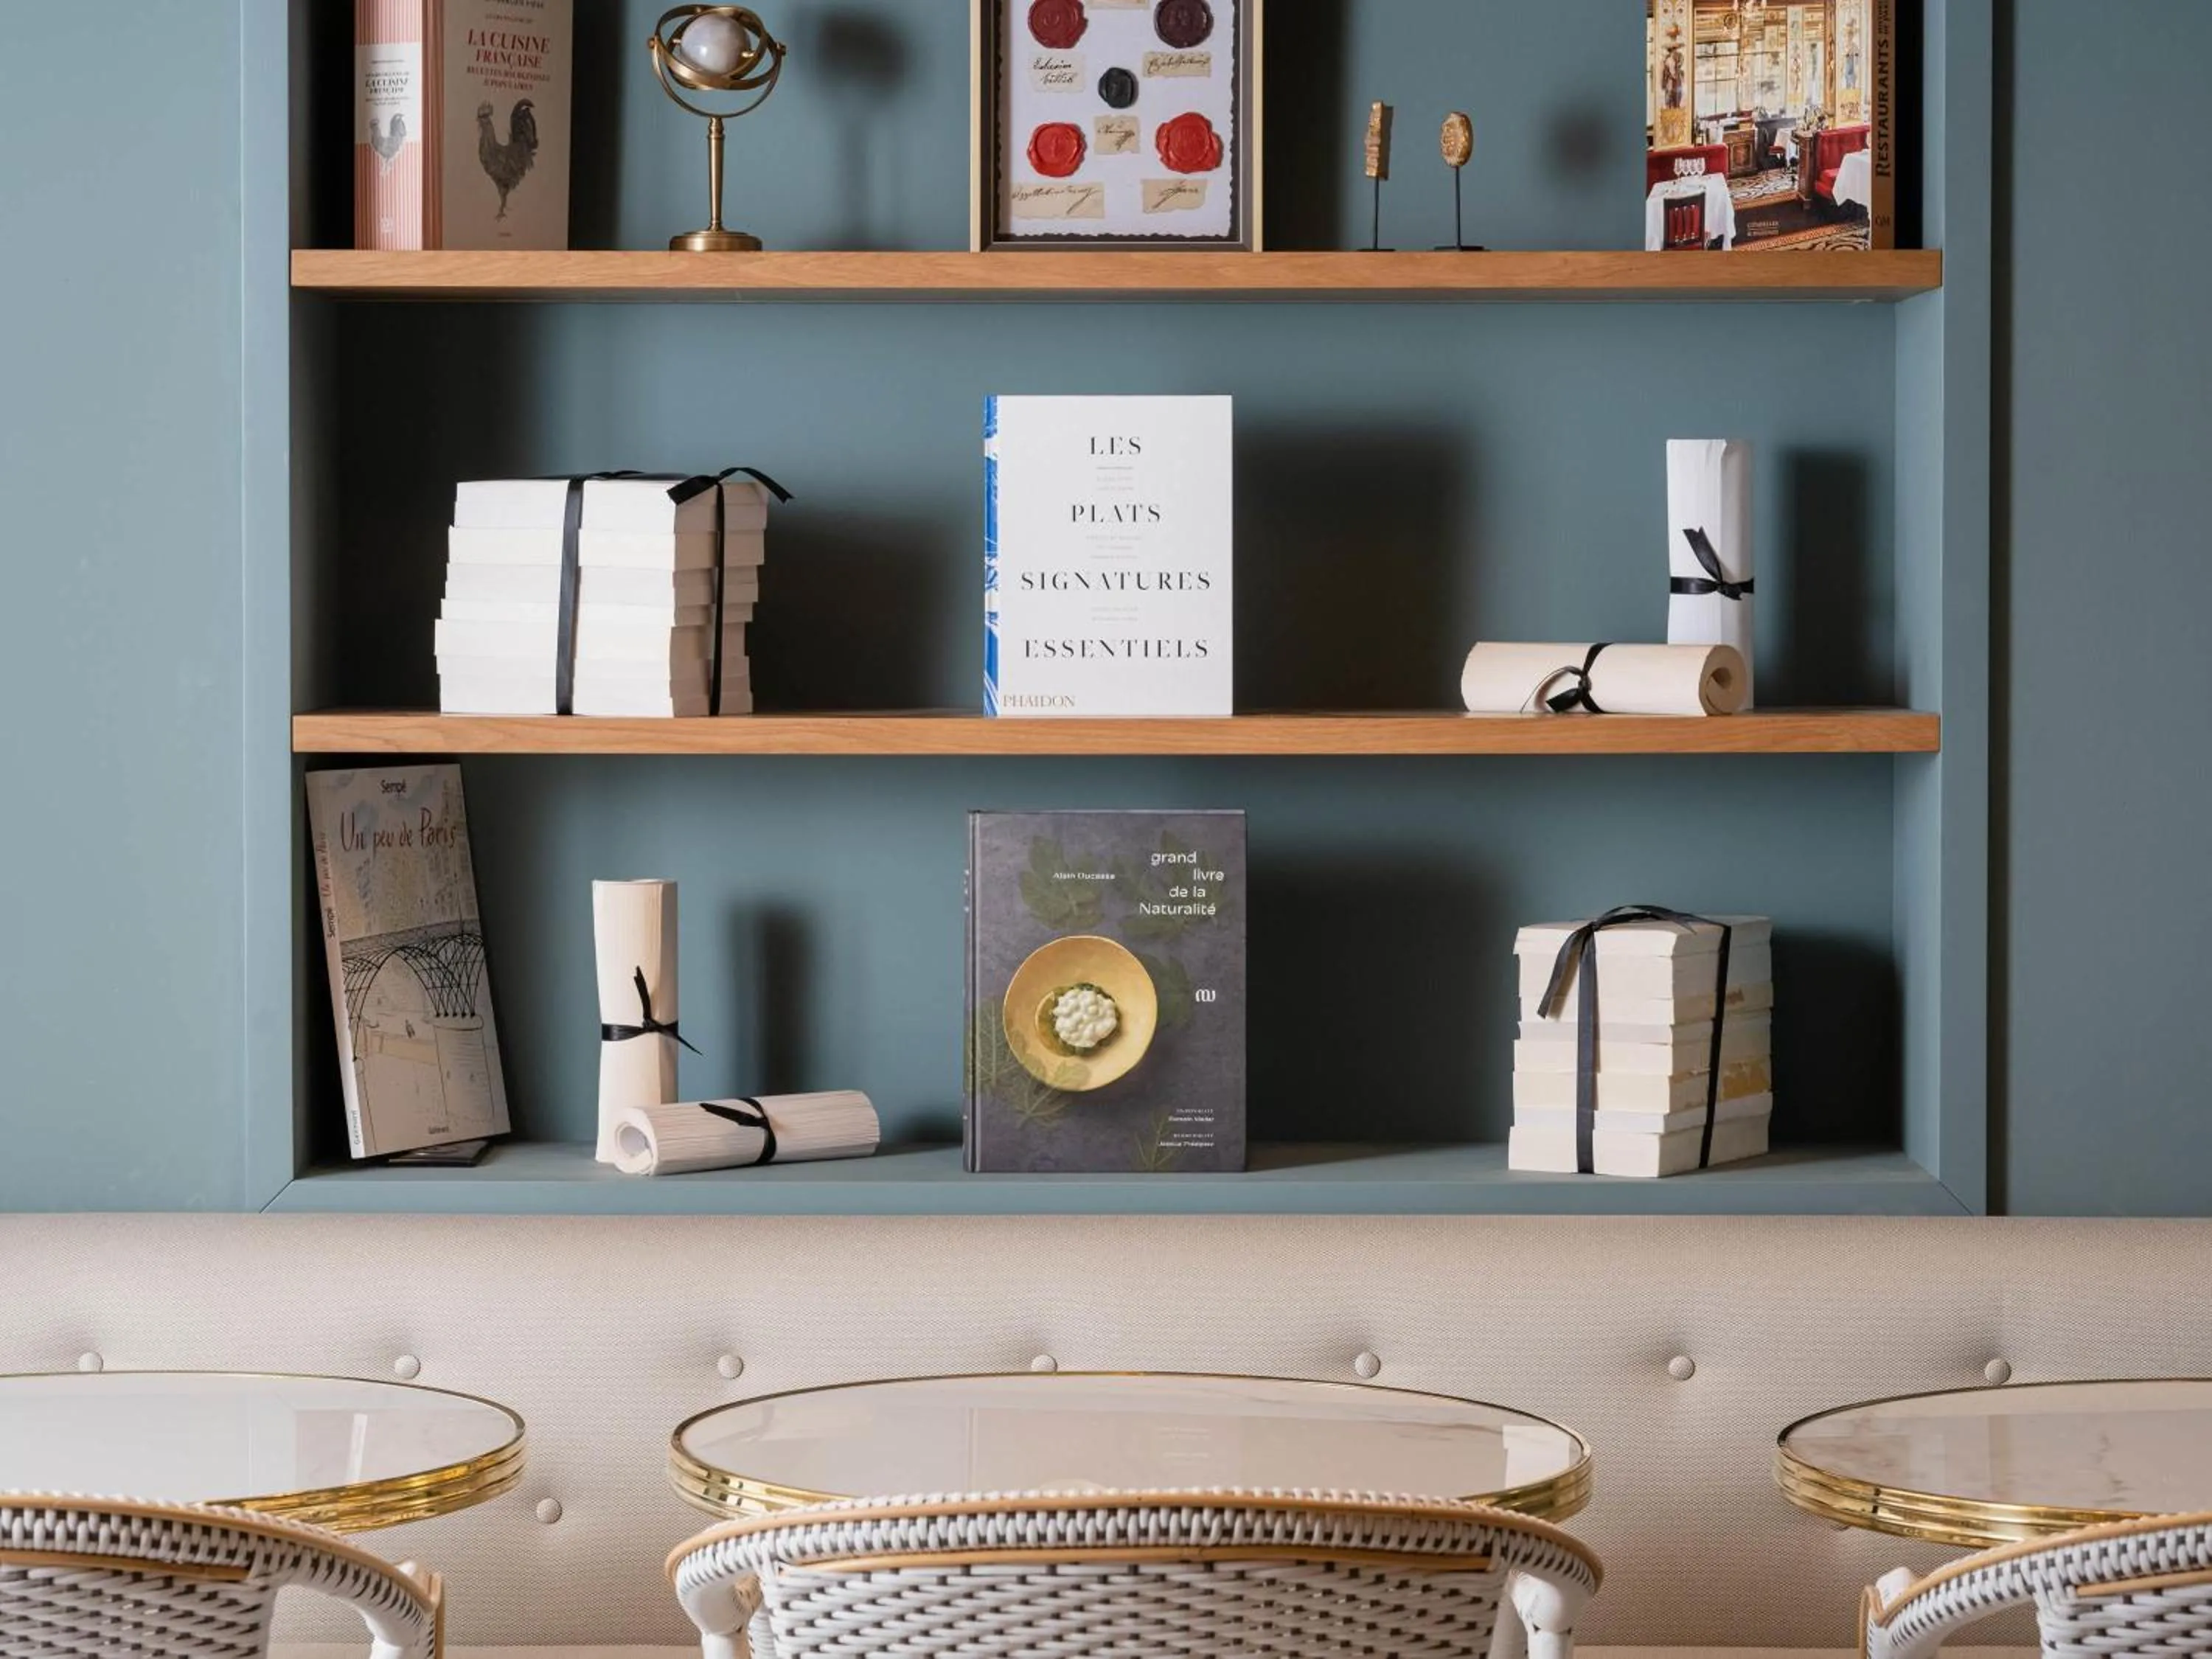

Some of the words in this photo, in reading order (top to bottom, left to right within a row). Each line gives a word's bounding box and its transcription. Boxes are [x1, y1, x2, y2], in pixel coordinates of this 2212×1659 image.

[467, 28, 486, 46] LA
[490, 31, 550, 53] CUISINE
[476, 49, 543, 70] FRANÇAISE
[1874, 39, 1891, 177] RESTAURANTS
[1090, 436, 1142, 455] LES
[1071, 504, 1161, 523] PLATS
[1020, 571, 1211, 591] SIGNATURES
[1025, 639, 1208, 658] ESSENTIELS
[1004, 695, 1075, 708] PHAIDON
[380, 779, 407, 799] Sempé
[341, 812, 364, 852] Un
[372, 829, 394, 860] peu
[399, 820, 413, 847] de
[419, 807, 456, 849] Paris
[1150, 851, 1197, 866] grand
[1193, 868, 1225, 881] livre
[1169, 885, 1189, 897] de
[1192, 885, 1206, 897] la
[1139, 902, 1217, 916] Naturalité
